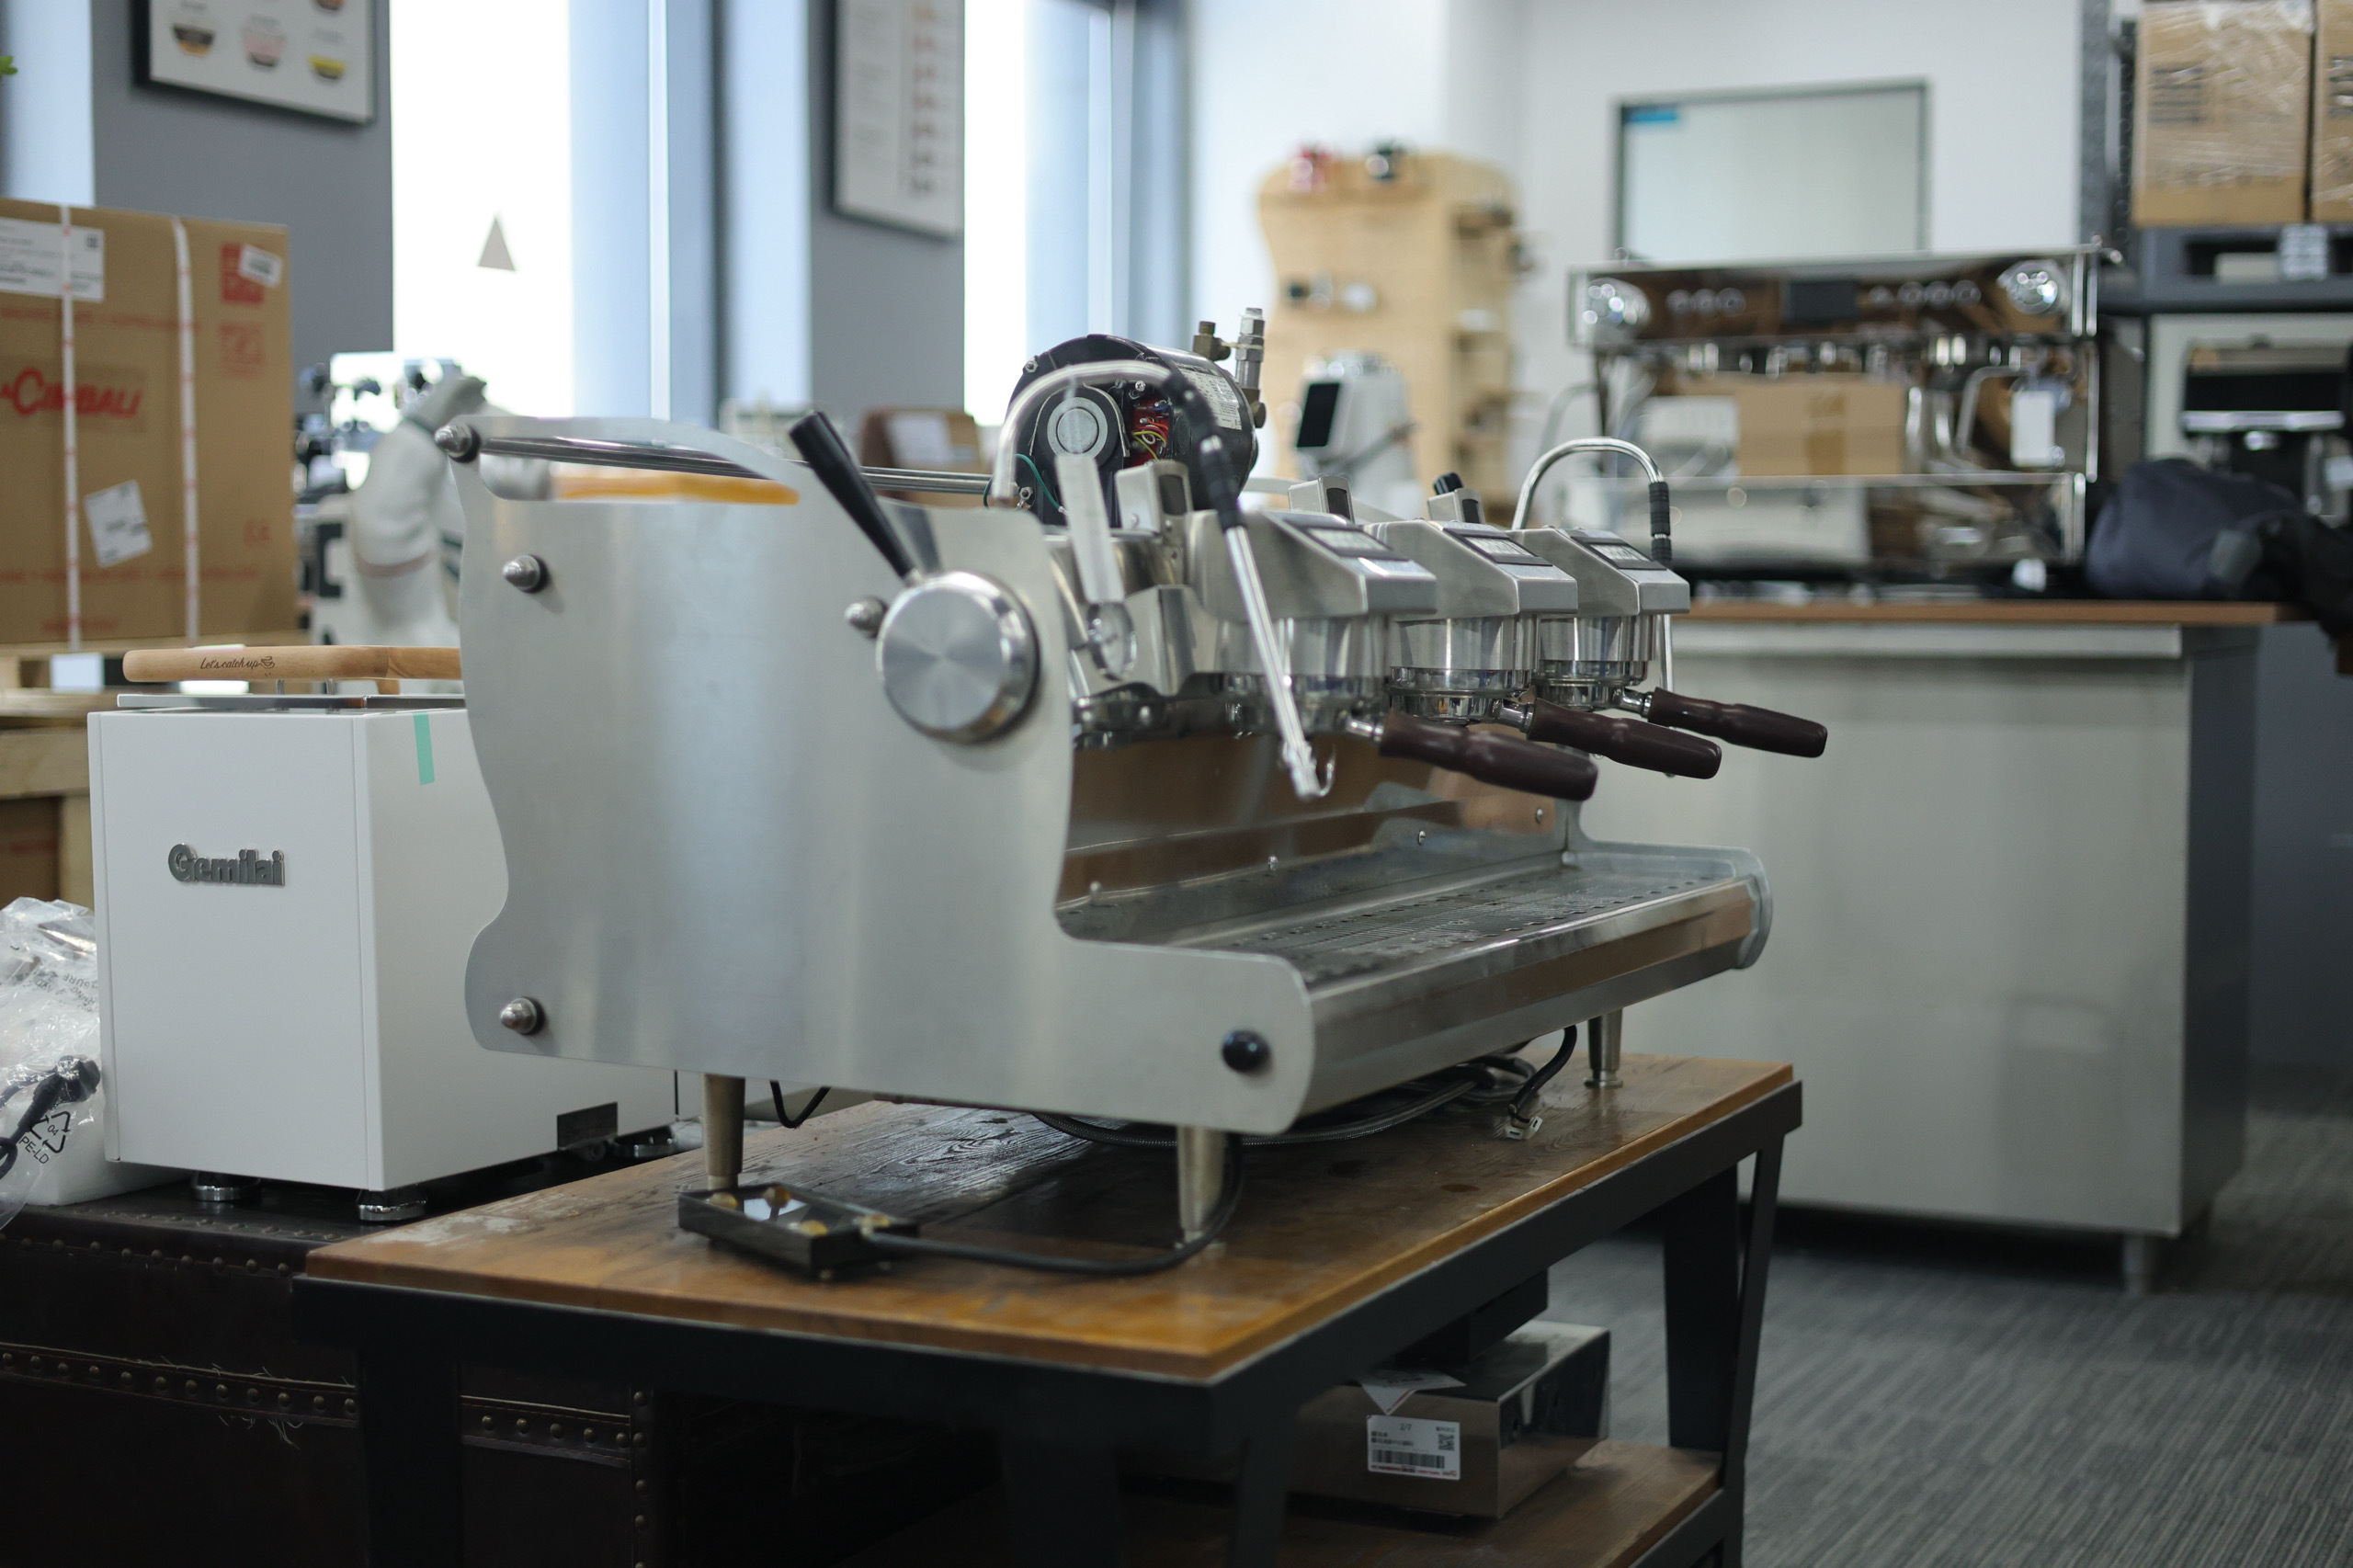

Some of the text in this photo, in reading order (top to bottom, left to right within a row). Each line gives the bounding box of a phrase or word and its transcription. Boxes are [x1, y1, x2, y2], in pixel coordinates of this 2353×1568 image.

[168, 843, 285, 887] Gemilai
[47, 1124, 59, 1136] 04
[18, 1135, 50, 1165] PE-LD
